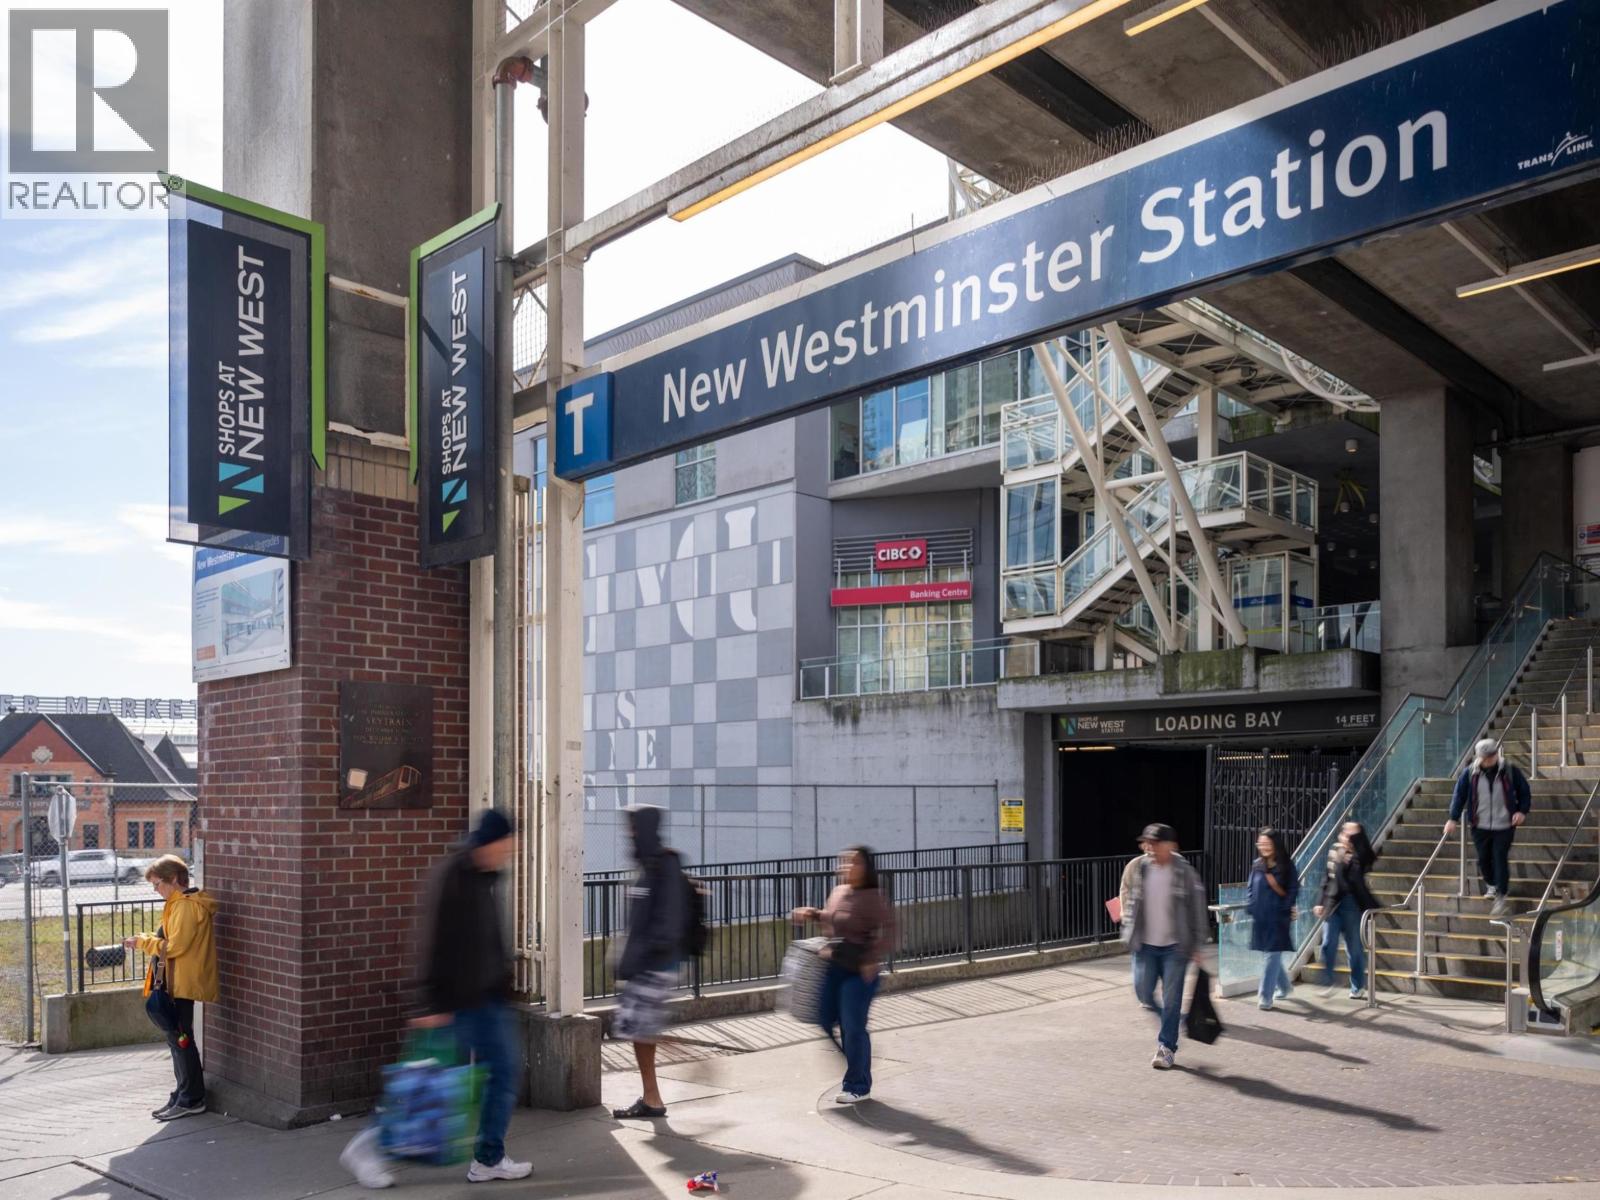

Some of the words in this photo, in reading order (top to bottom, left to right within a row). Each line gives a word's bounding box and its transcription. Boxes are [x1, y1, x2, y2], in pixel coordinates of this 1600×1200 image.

[661, 357, 746, 423] New
[760, 224, 1114, 389] Westminster
[1138, 110, 1448, 264] Station
[237, 244, 265, 357] WEST
[451, 270, 468, 376] WEST
[218, 360, 236, 384] AT
[441, 388, 452, 405] AT
[218, 388, 236, 456] SHOPS
[237, 365, 265, 461] NEW
[452, 385, 468, 473] NEW
[565, 391, 594, 456] T
[442, 416, 452, 475] SHOPS
[878, 547, 908, 561] CIBC
[910, 589, 941, 599] Banking
[941, 588, 968, 597] Centre
[1078, 721, 1098, 729] NEW
[1100, 719, 1125, 729] WEST
[1155, 713, 1237, 732] LOADING
[1245, 710, 1282, 728] BAY
[1336, 715, 1347, 724] 14
[1350, 713, 1376, 723] FEET
